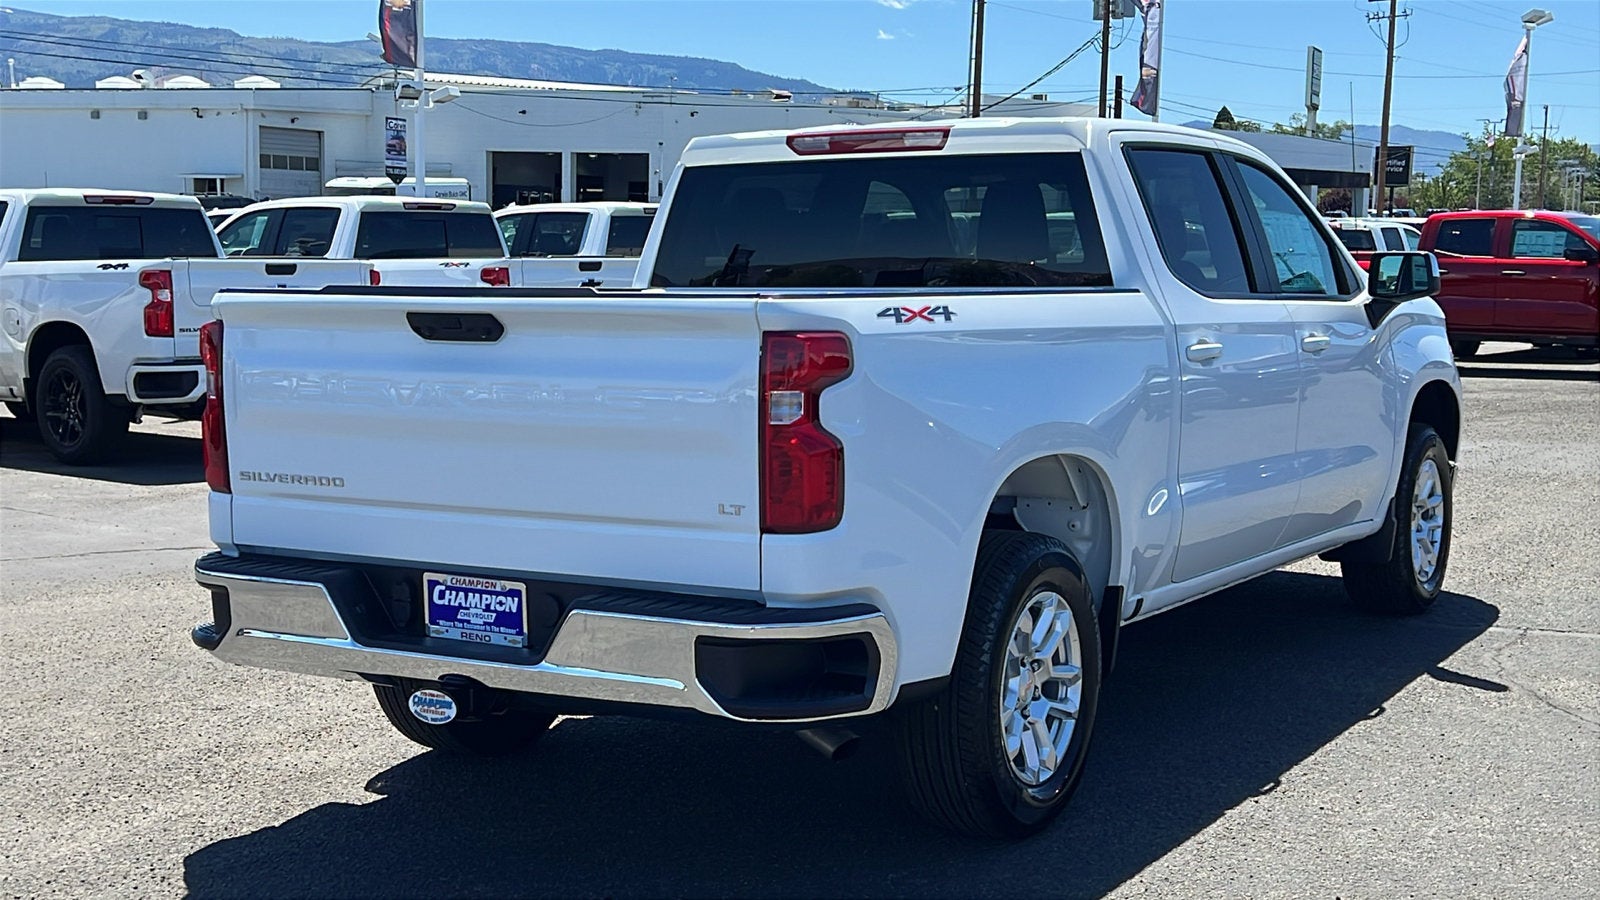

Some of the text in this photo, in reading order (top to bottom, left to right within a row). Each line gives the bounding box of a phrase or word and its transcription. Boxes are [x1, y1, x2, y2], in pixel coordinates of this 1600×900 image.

[1386, 159, 1406, 167] rtified
[239, 470, 345, 488] SILVERADO
[717, 503, 747, 516] LT
[450, 577, 497, 590] CHAMPION
[460, 611, 494, 621] CHEVROLET
[460, 631, 492, 643] RENO
